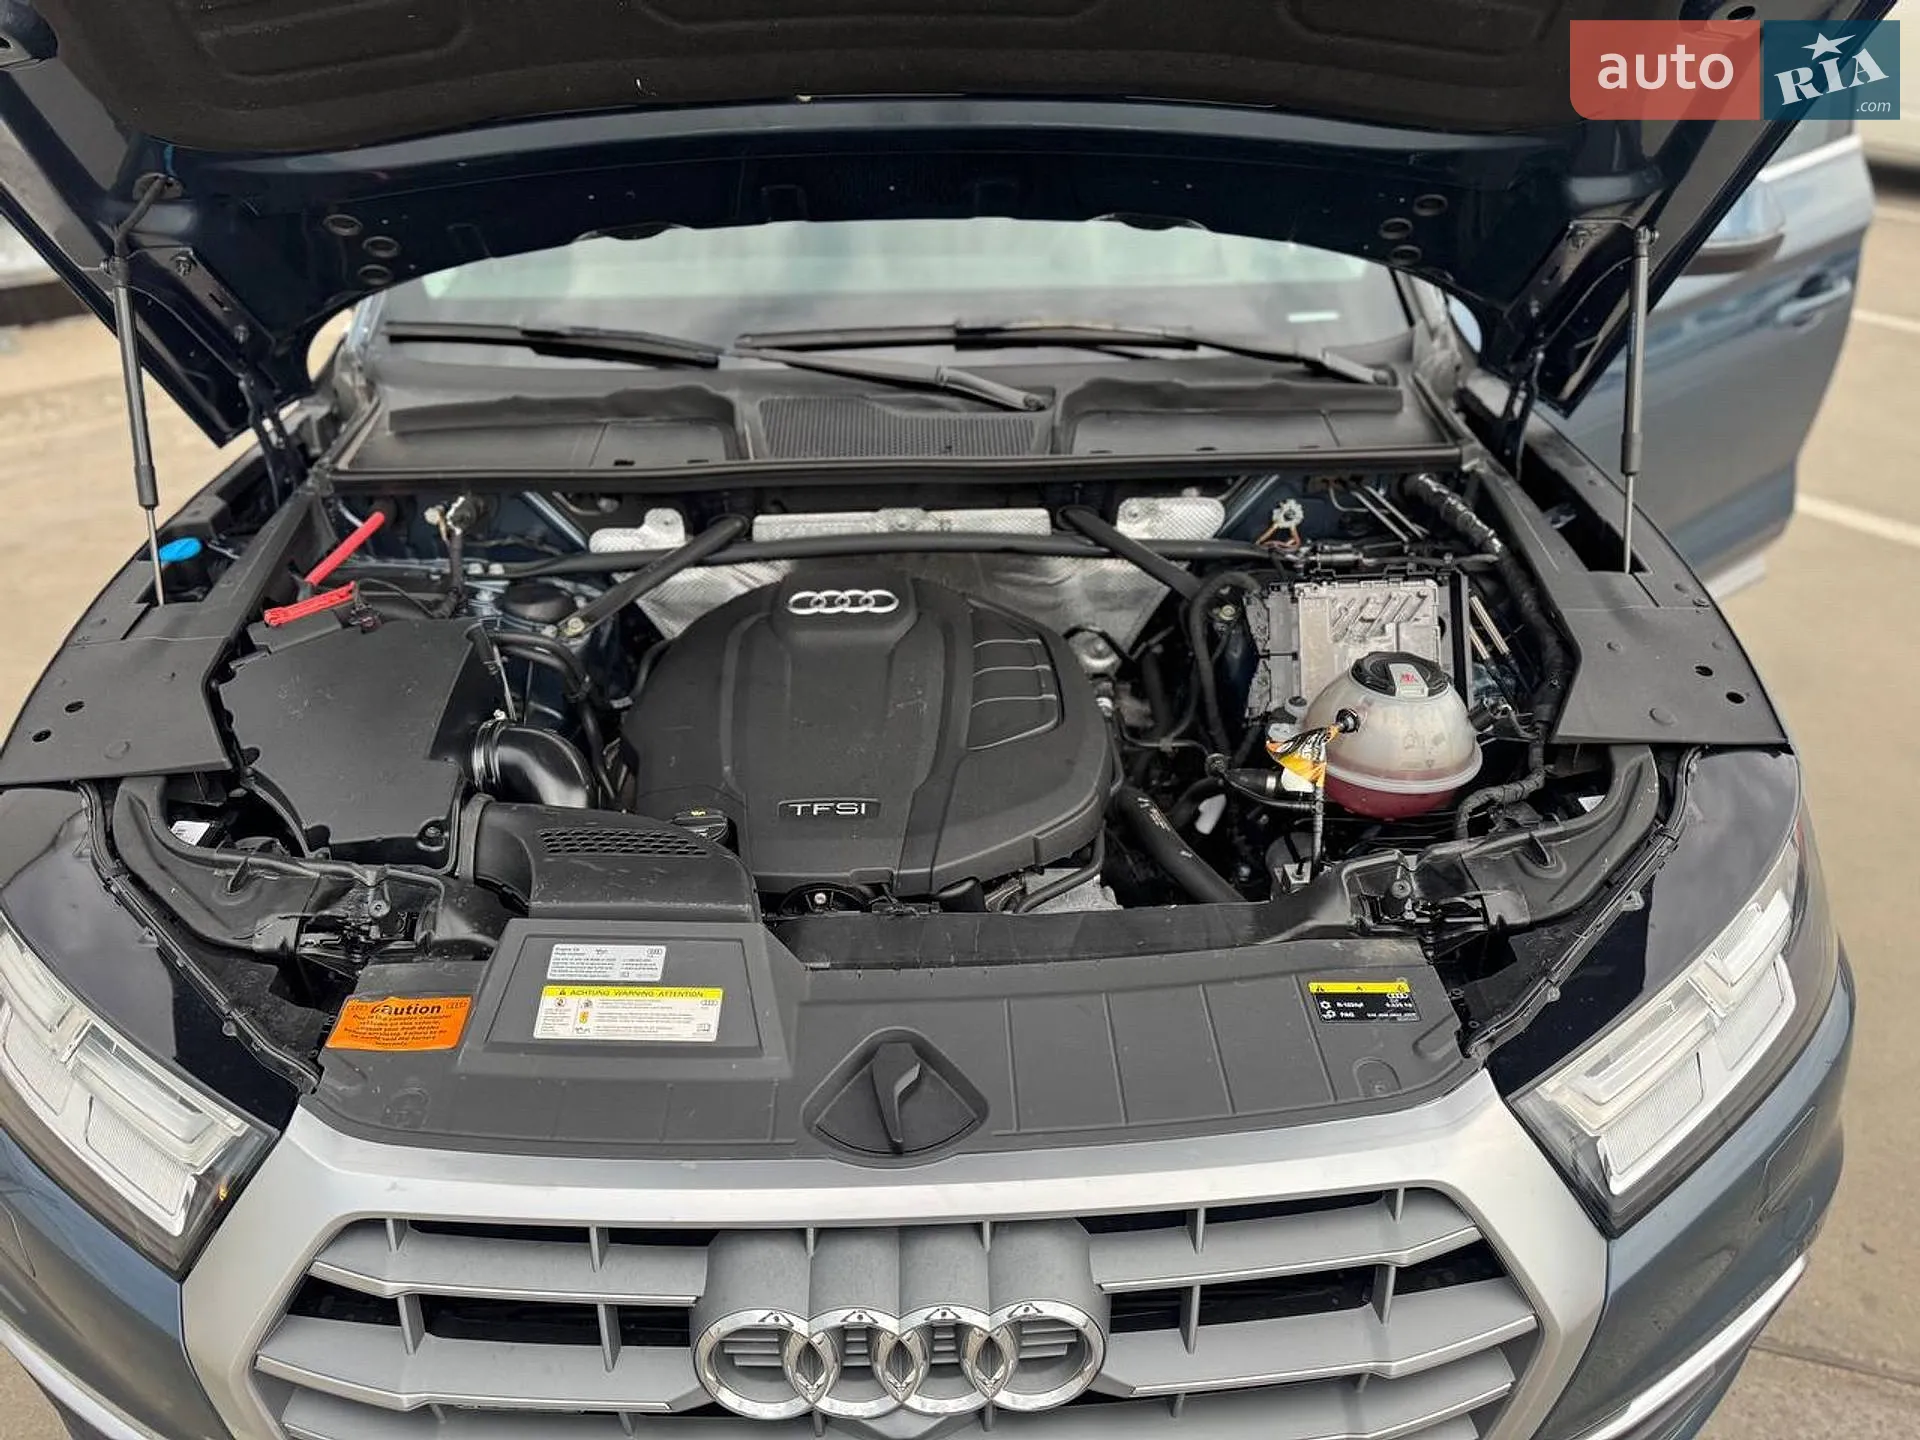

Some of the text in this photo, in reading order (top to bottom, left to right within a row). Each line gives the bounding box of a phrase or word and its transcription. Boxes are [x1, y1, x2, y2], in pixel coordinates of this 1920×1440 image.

[788, 802, 866, 816] TFSI
[570, 989, 610, 997] ACHTUNG
[614, 990, 654, 998] WARNING
[370, 1003, 442, 1016] Caution
